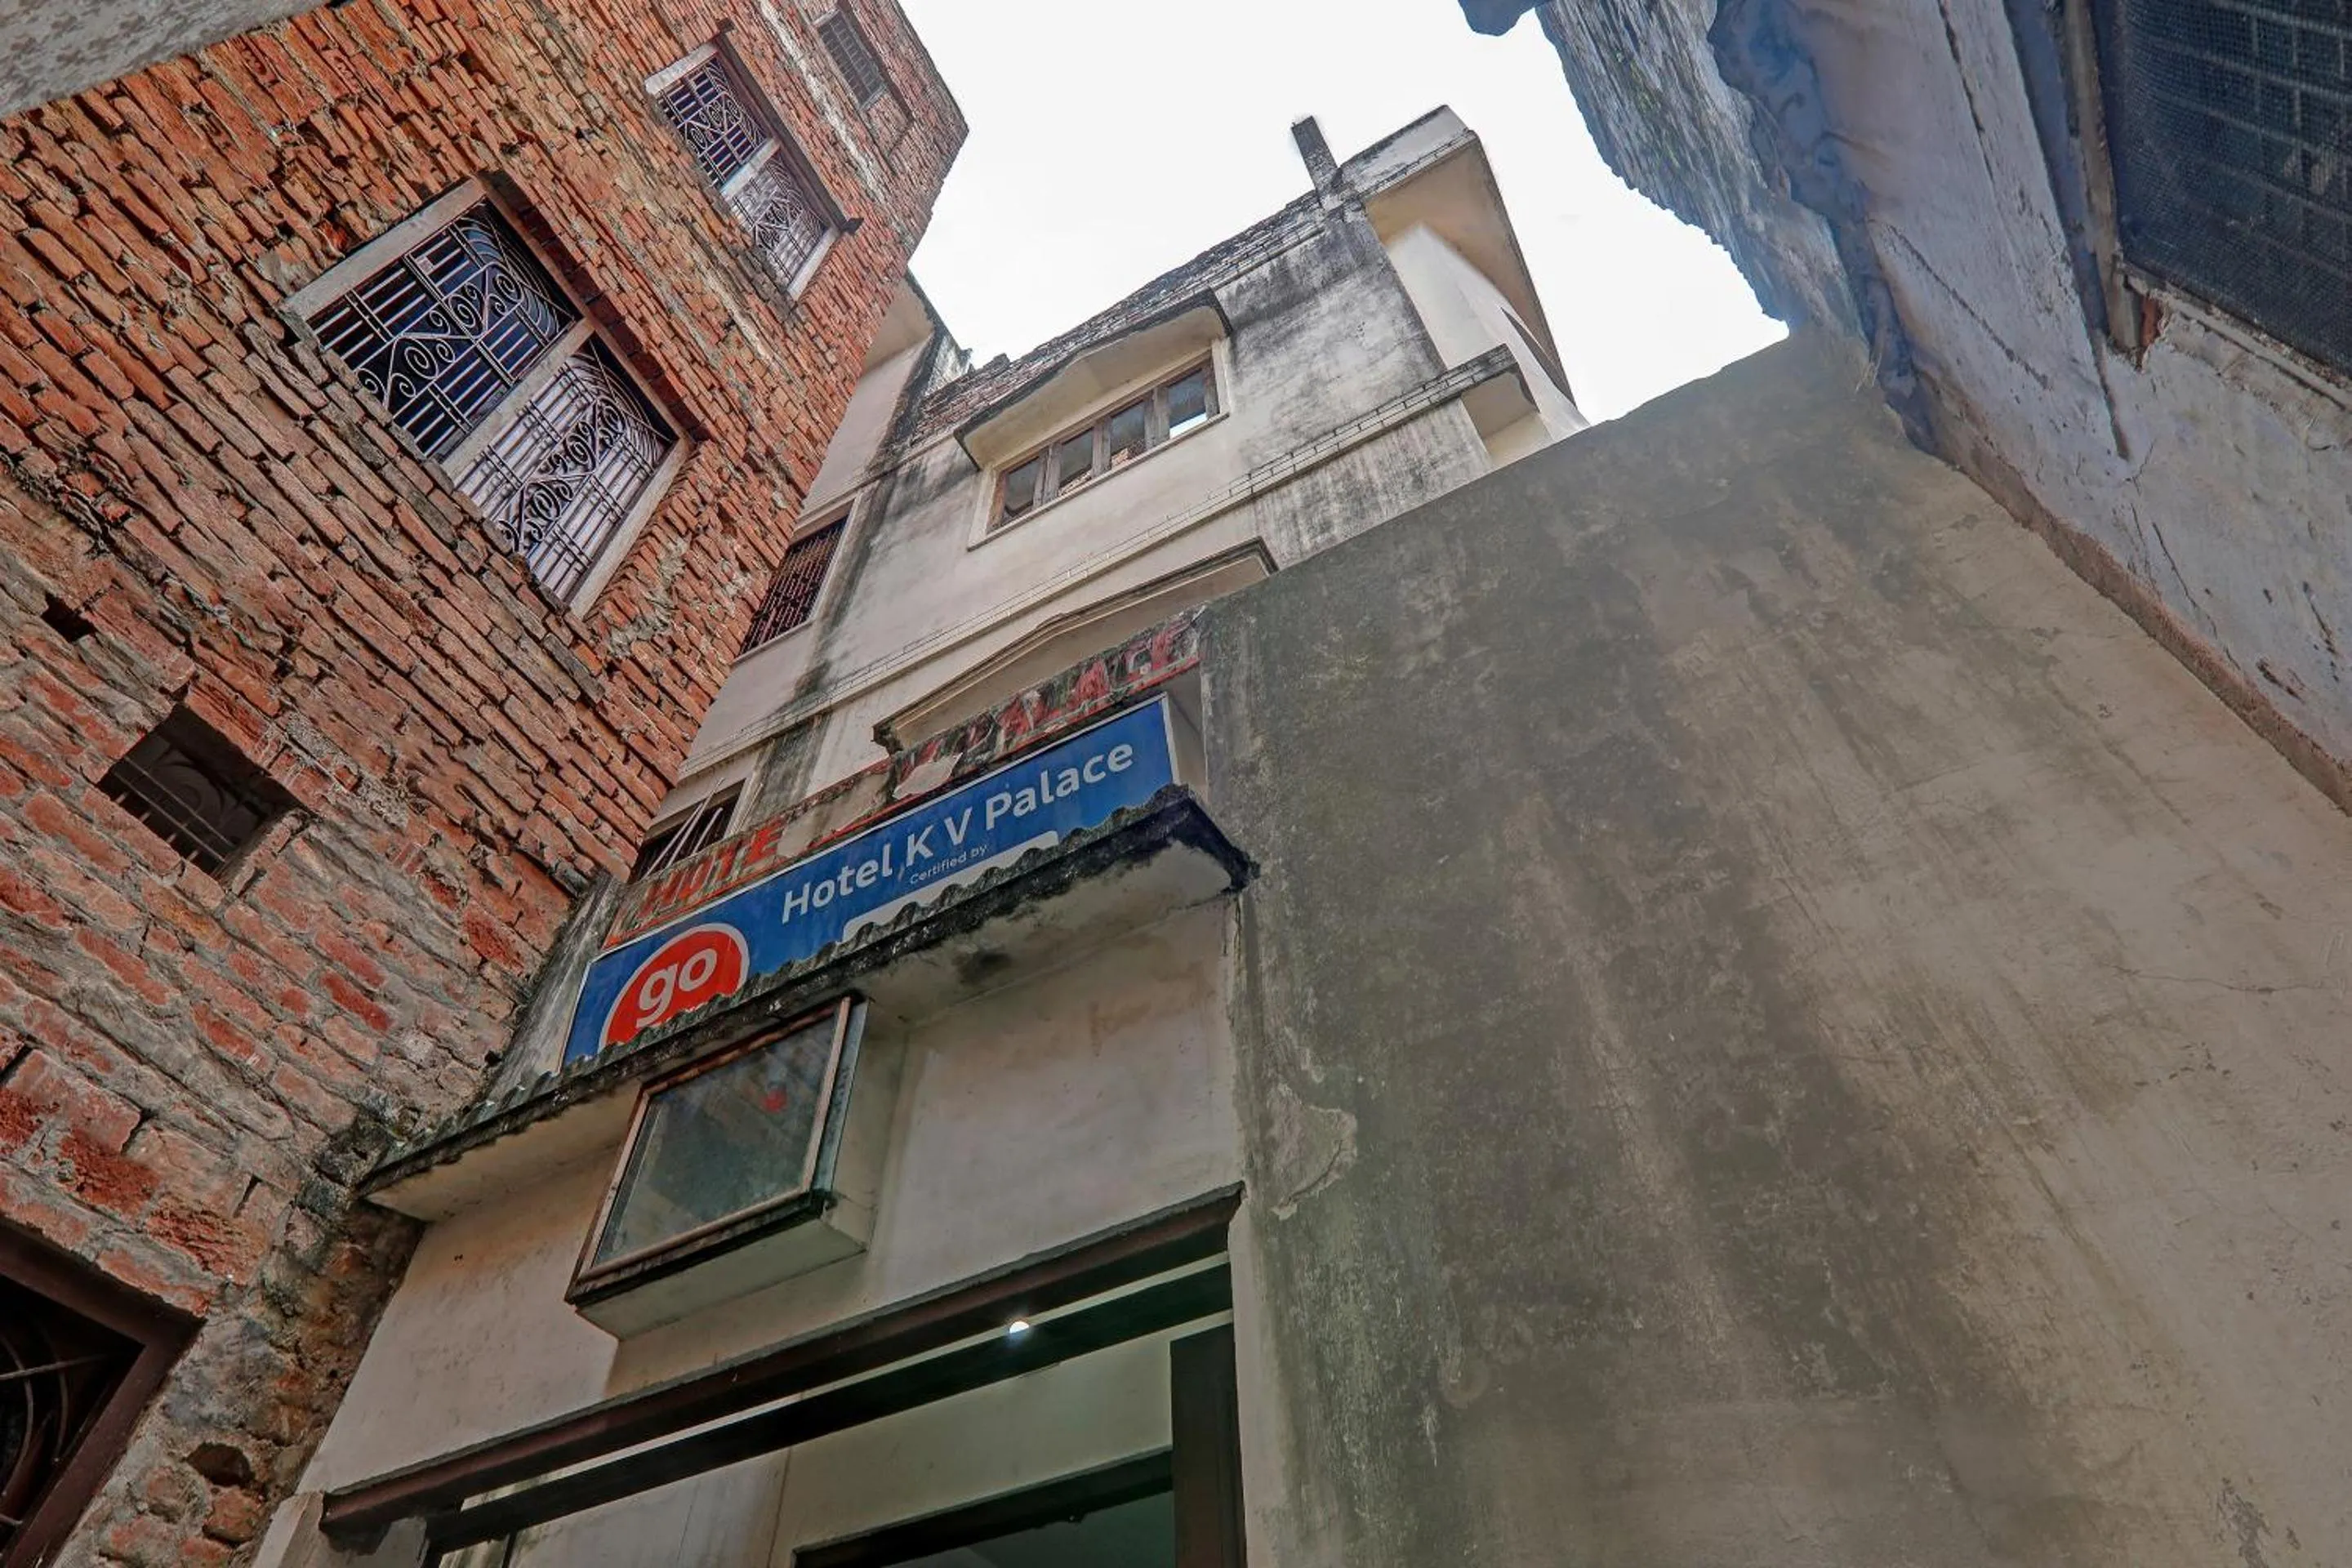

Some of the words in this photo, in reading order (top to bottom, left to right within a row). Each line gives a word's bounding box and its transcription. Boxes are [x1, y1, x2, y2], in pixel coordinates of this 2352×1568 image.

[782, 843, 893, 924] Hotel
[905, 824, 934, 868] K
[944, 806, 973, 847] V
[985, 743, 1134, 831] Palace
[909, 850, 968, 885] Certified
[969, 842, 989, 858] by
[635, 948, 718, 1029] go
